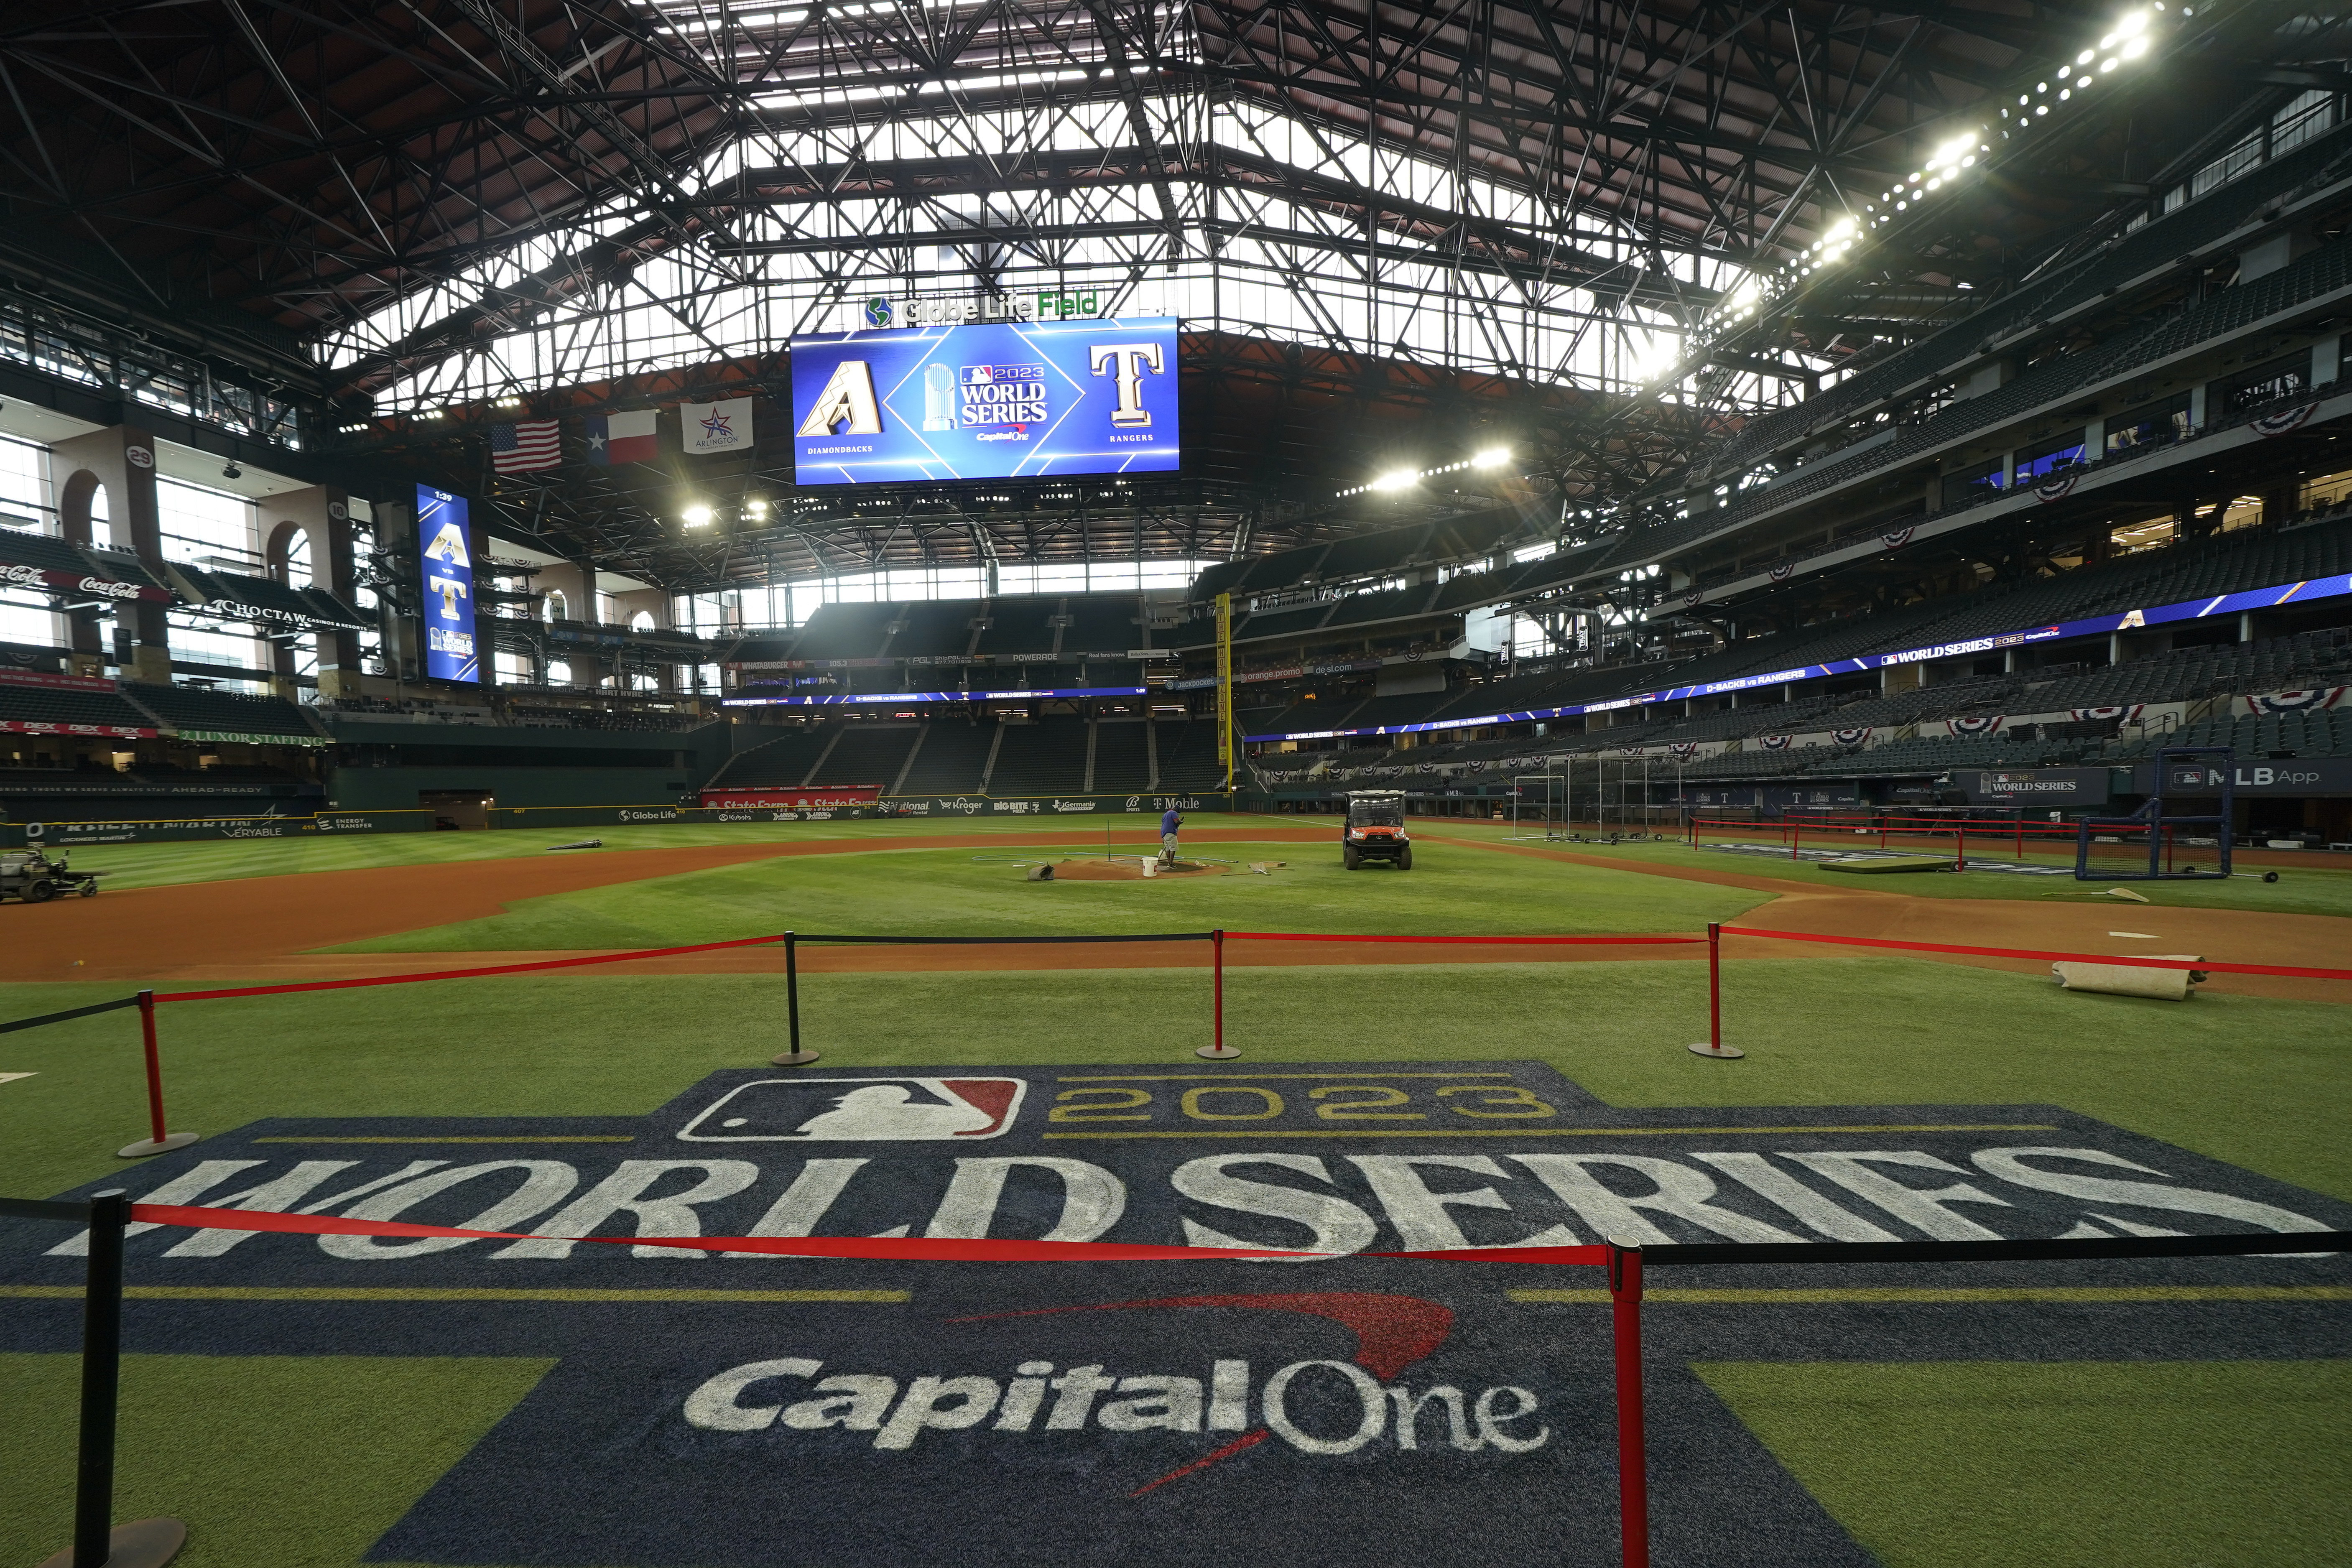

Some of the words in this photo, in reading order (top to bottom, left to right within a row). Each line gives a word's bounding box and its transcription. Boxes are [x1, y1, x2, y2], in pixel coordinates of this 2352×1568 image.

[902, 297, 978, 322] Globe
[985, 293, 1032, 319] Life
[1038, 290, 1097, 317] Field
[994, 367, 1045, 380] 2023
[1090, 343, 1165, 428] T
[960, 382, 1046, 404] WORLD
[961, 402, 1048, 425] SERIES
[696, 436, 738, 447] ARLINGTON
[1110, 433, 1153, 443] RANGERS
[130, 449, 150, 464] 29
[808, 445, 872, 455] DIAMONDBACKS
[435, 491, 452, 501] 1:39
[333, 505, 344, 516] 10
[430, 575, 467, 621] T
[221, 600, 306, 623] CHOCTAW
[442, 636, 473, 647] WORLD
[443, 643, 474, 655] SERIES
[1897, 646, 1944, 663] WORLD
[1944, 638, 1994, 656] SERIES
[1995, 635, 2025, 646] 2023
[741, 661, 789, 670] WHATABURGER
[1248, 668, 1300, 681] orange.promo
[1707, 680, 1746, 692] D-BACKS
[1758, 670, 1805, 684] RANGERS
[1591, 703, 1610, 712] WORLD
[1610, 699, 1630, 709] SERIES
[1467, 716, 1498, 725] RANGERS
[196, 731, 251, 743] LUXOR
[254, 734, 323, 747] STAFFING
[1992, 782, 2033, 791] WORLD
[2034, 781, 2076, 791] SERIES
[1721, 793, 1728, 803] T
[1793, 792, 1801, 803] T
[953, 797, 983, 814] Kroger
[1010, 801, 1028, 810] BITE
[632, 811, 659, 820] Globe
[660, 810, 676, 818] Life
[1048, 1084, 1559, 1123] 2023
[46, 1156, 1127, 1259] WORLD
[1171, 1145, 2344, 1262] SERIES
